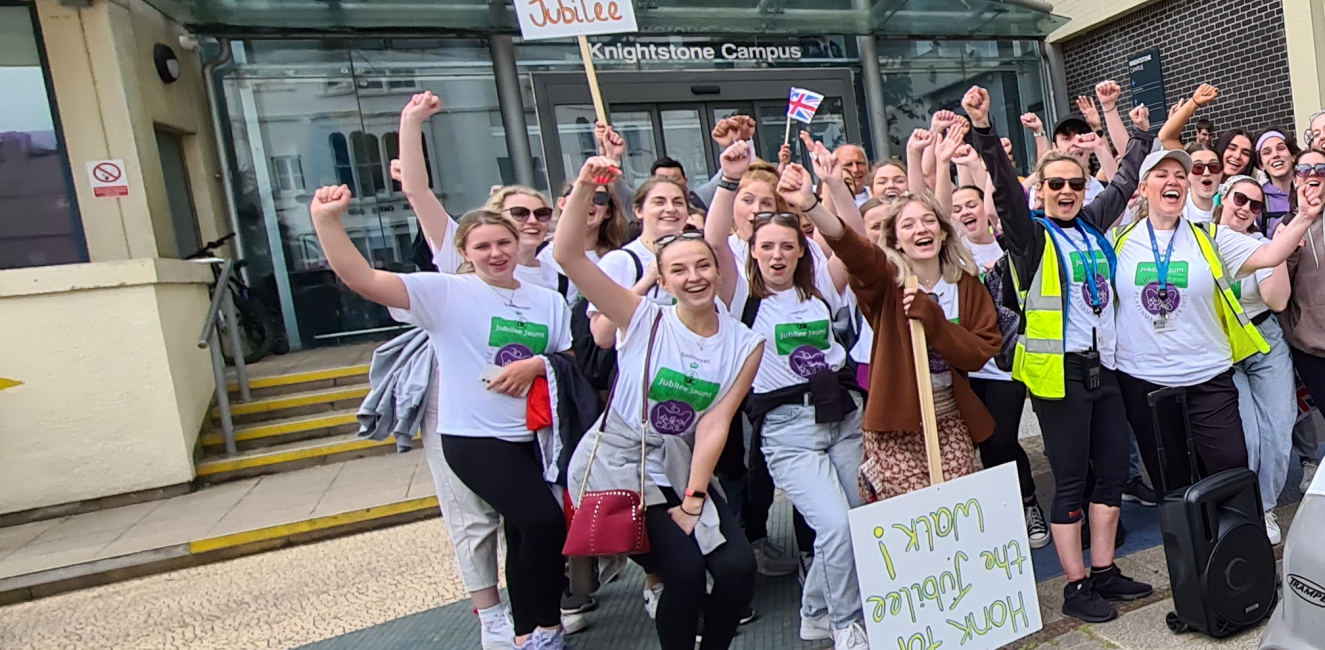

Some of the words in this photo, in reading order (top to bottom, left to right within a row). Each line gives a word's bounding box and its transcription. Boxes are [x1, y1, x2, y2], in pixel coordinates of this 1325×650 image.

[528, 0, 623, 27] Jubilee
[589, 42, 715, 63] Knightstone
[721, 42, 802, 61] Campus
[495, 324, 524, 336] Jubilee
[523, 329, 545, 339] Jaunt
[780, 331, 807, 340] Jubilee
[658, 377, 688, 393] Jubilee
[689, 387, 713, 398] Jaunt
[979, 540, 1027, 580] the
[866, 551, 972, 623] Jubilee
[946, 591, 1029, 646] Honk
